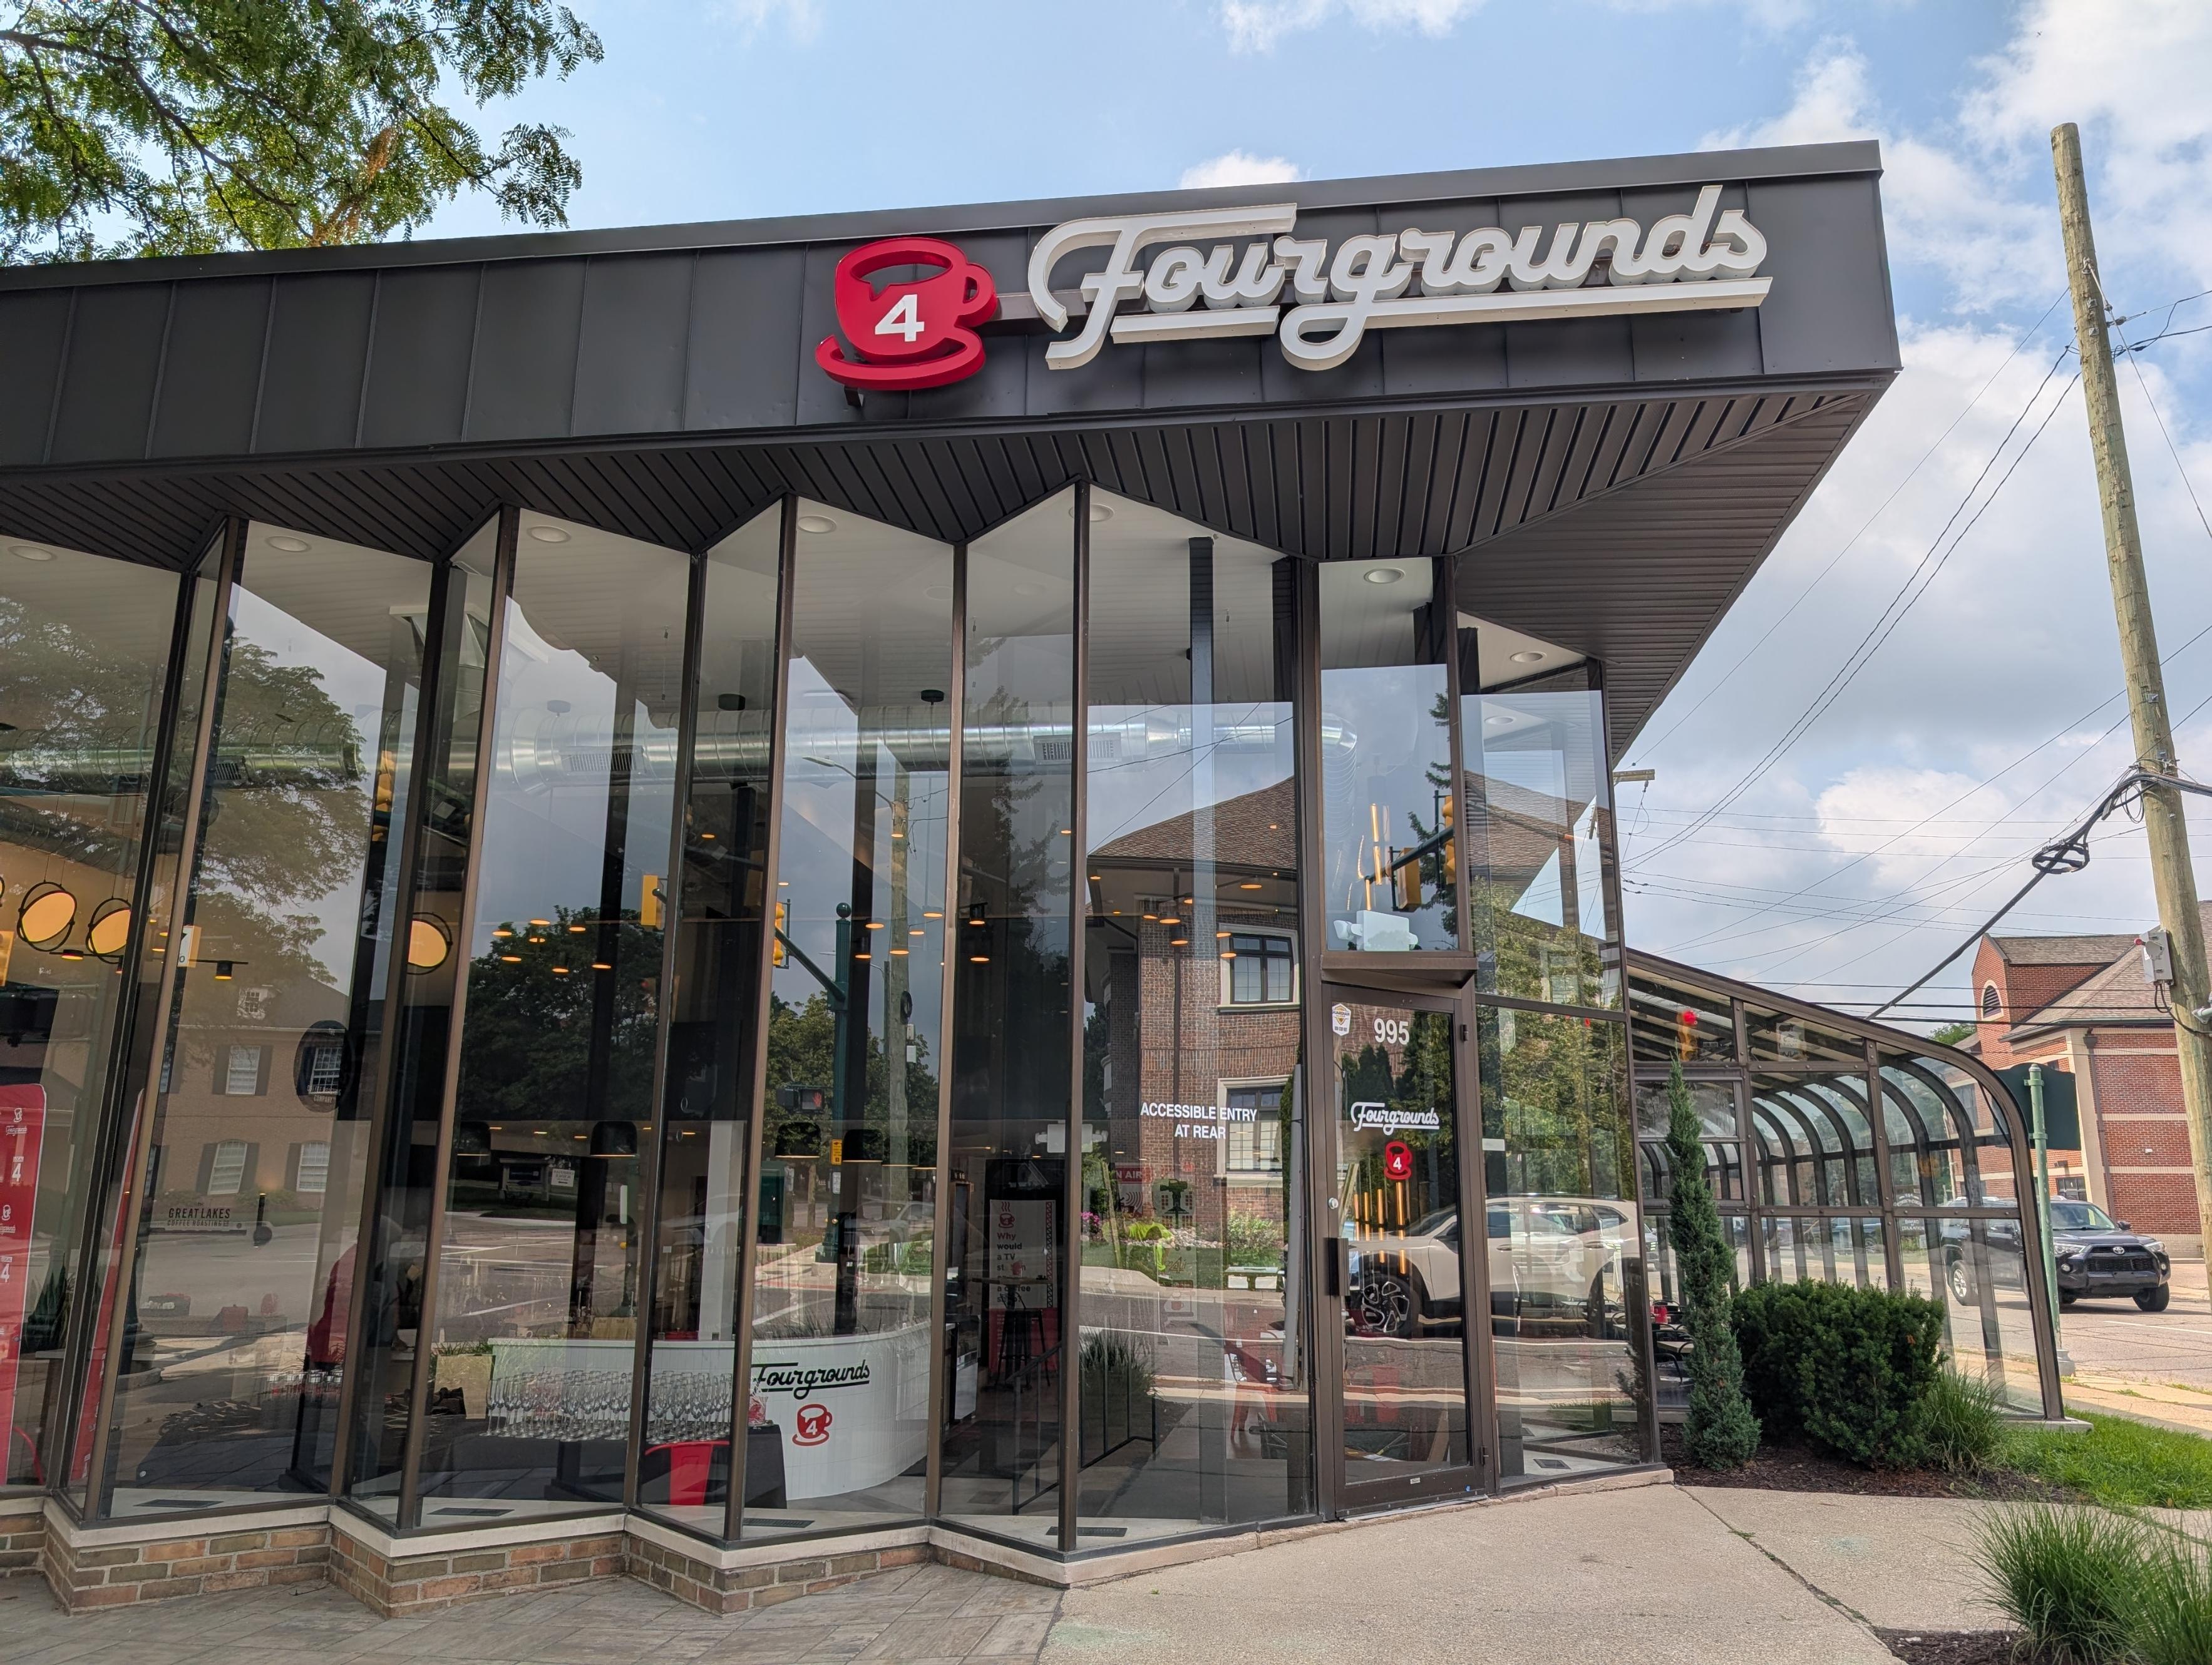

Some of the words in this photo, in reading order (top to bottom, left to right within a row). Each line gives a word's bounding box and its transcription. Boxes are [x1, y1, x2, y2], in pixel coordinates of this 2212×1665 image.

[1029, 185, 1772, 372] Fourgrounds
[875, 294, 925, 342] 4
[1374, 1018, 1409, 1045] 995
[1140, 1102, 1217, 1120] ACCESSIBLE
[1220, 1107, 1257, 1122] ENTRY
[1350, 1102, 1440, 1135] Fourgrounds
[1174, 1124, 1190, 1138] AT
[1193, 1125, 1226, 1139] REAR
[11, 1163, 21, 1182] 4
[1392, 1157, 1402, 1171] 4
[168, 1208, 199, 1219] GREAT
[200, 1208, 230, 1219] LAKES
[997, 1232, 1016, 1241] Why
[0, 1264, 10, 1283] 4
[750, 1360, 870, 1400] Fourgrounds
[806, 1420, 818, 1435] 4
